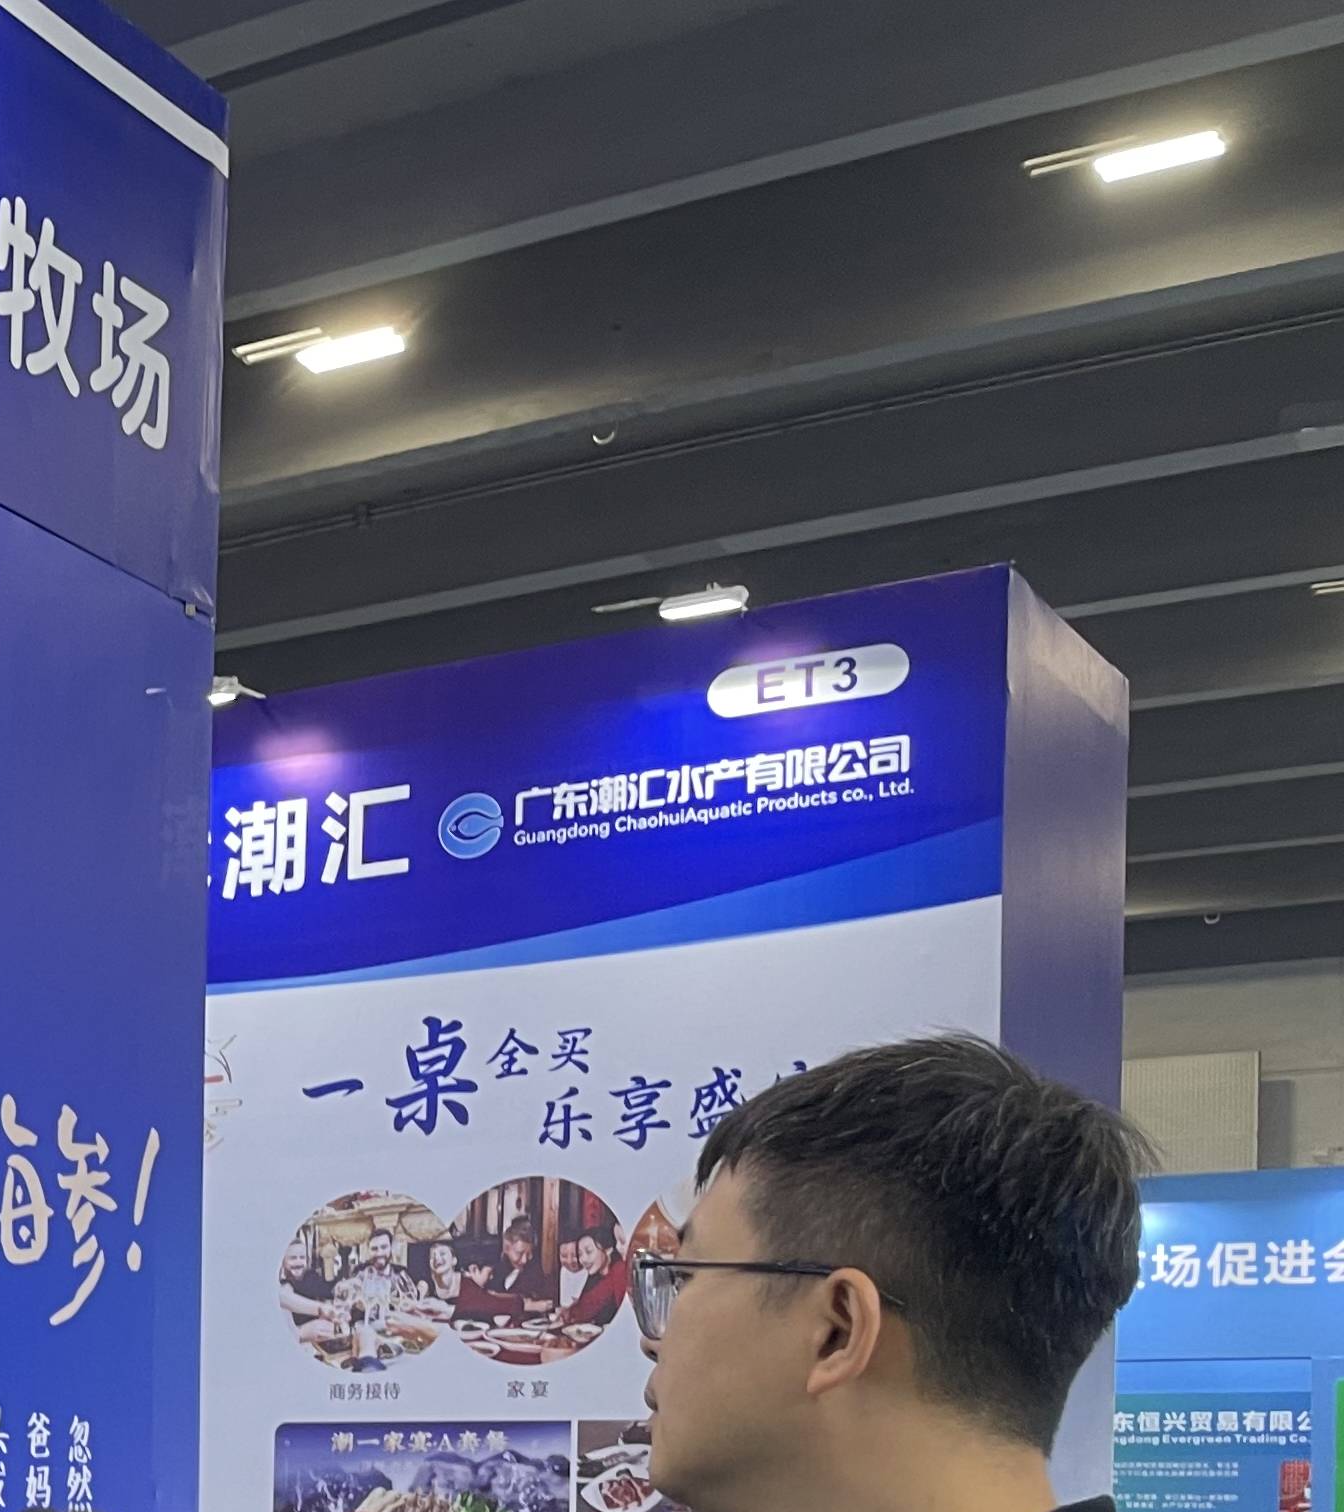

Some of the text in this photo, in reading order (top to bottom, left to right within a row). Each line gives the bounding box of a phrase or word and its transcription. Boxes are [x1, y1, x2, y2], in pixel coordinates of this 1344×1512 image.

[757, 656, 858, 705] ET3
[514, 734, 911, 826] 广东潮汇水产有限公司
[513, 819, 611, 847] Guangdong
[756, 789, 838, 814] Products
[878, 777, 915, 799] Ltd.
[207, 784, 411, 901] 潮汇
[1138, 1238, 1344, 1291] 场促进
[329, 1381, 401, 1401] 商务接待
[1162, 1433, 1232, 1447] Evergreen
[1235, 1433, 1287, 1447] Trading
